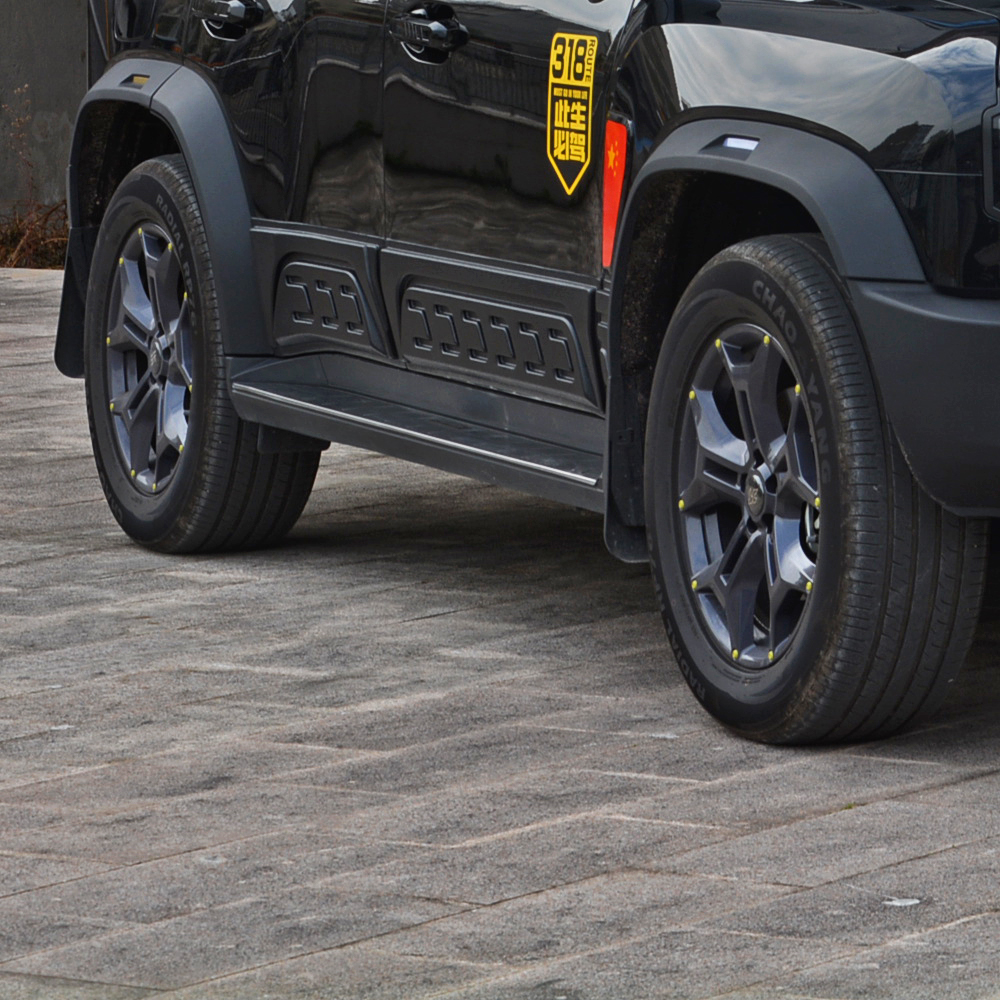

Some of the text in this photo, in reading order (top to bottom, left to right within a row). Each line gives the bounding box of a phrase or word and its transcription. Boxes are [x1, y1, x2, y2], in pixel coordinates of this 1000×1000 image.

[552, 37, 587, 81] 318
[585, 39, 596, 83] ROUTE
[554, 99, 586, 131] 此生
[553, 129, 586, 163] 必驾
[752, 279, 832, 484] CHAO YANG
